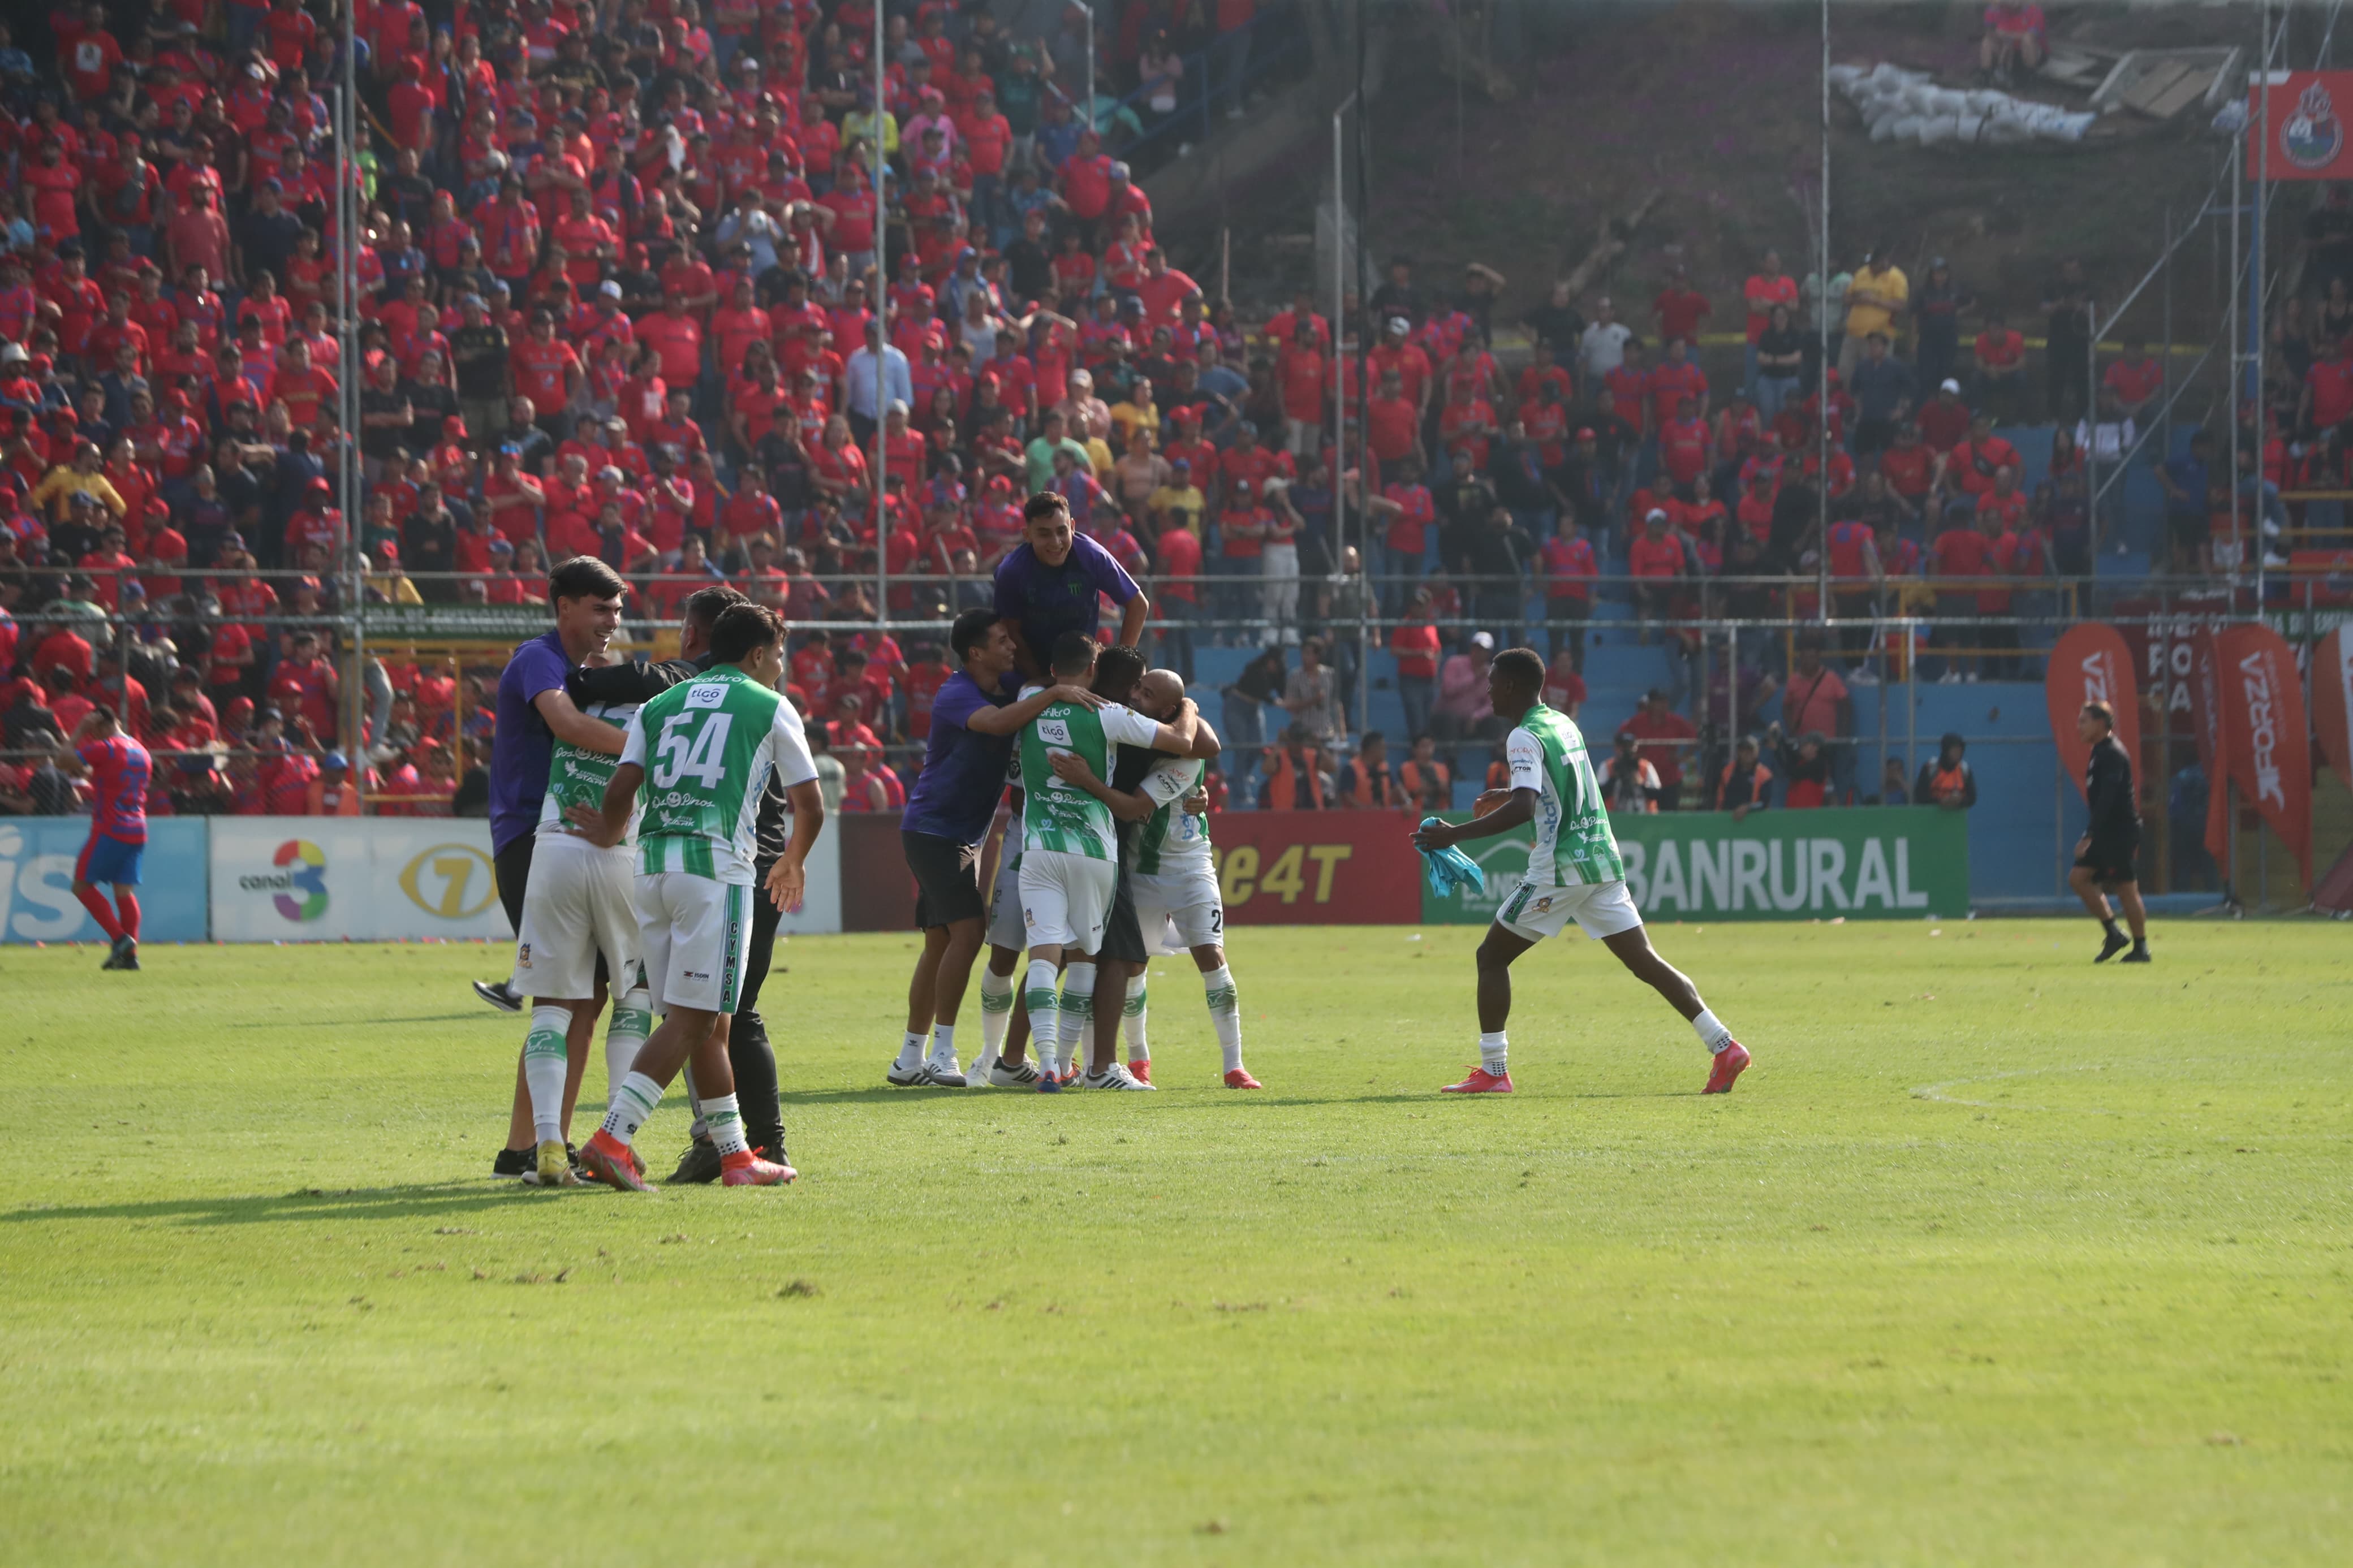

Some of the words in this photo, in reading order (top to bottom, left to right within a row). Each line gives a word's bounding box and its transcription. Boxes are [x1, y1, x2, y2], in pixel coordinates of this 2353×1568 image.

[691, 688, 721, 703] tigo
[589, 750, 622, 767] Pino
[653, 711, 734, 789] 54
[1041, 725, 1064, 741] tigo
[239, 870, 291, 891] canal
[272, 839, 329, 923] 3
[433, 857, 473, 917] 7
[1617, 838, 1928, 912] BANRURAL
[722, 922, 738, 1003] CYMSA
